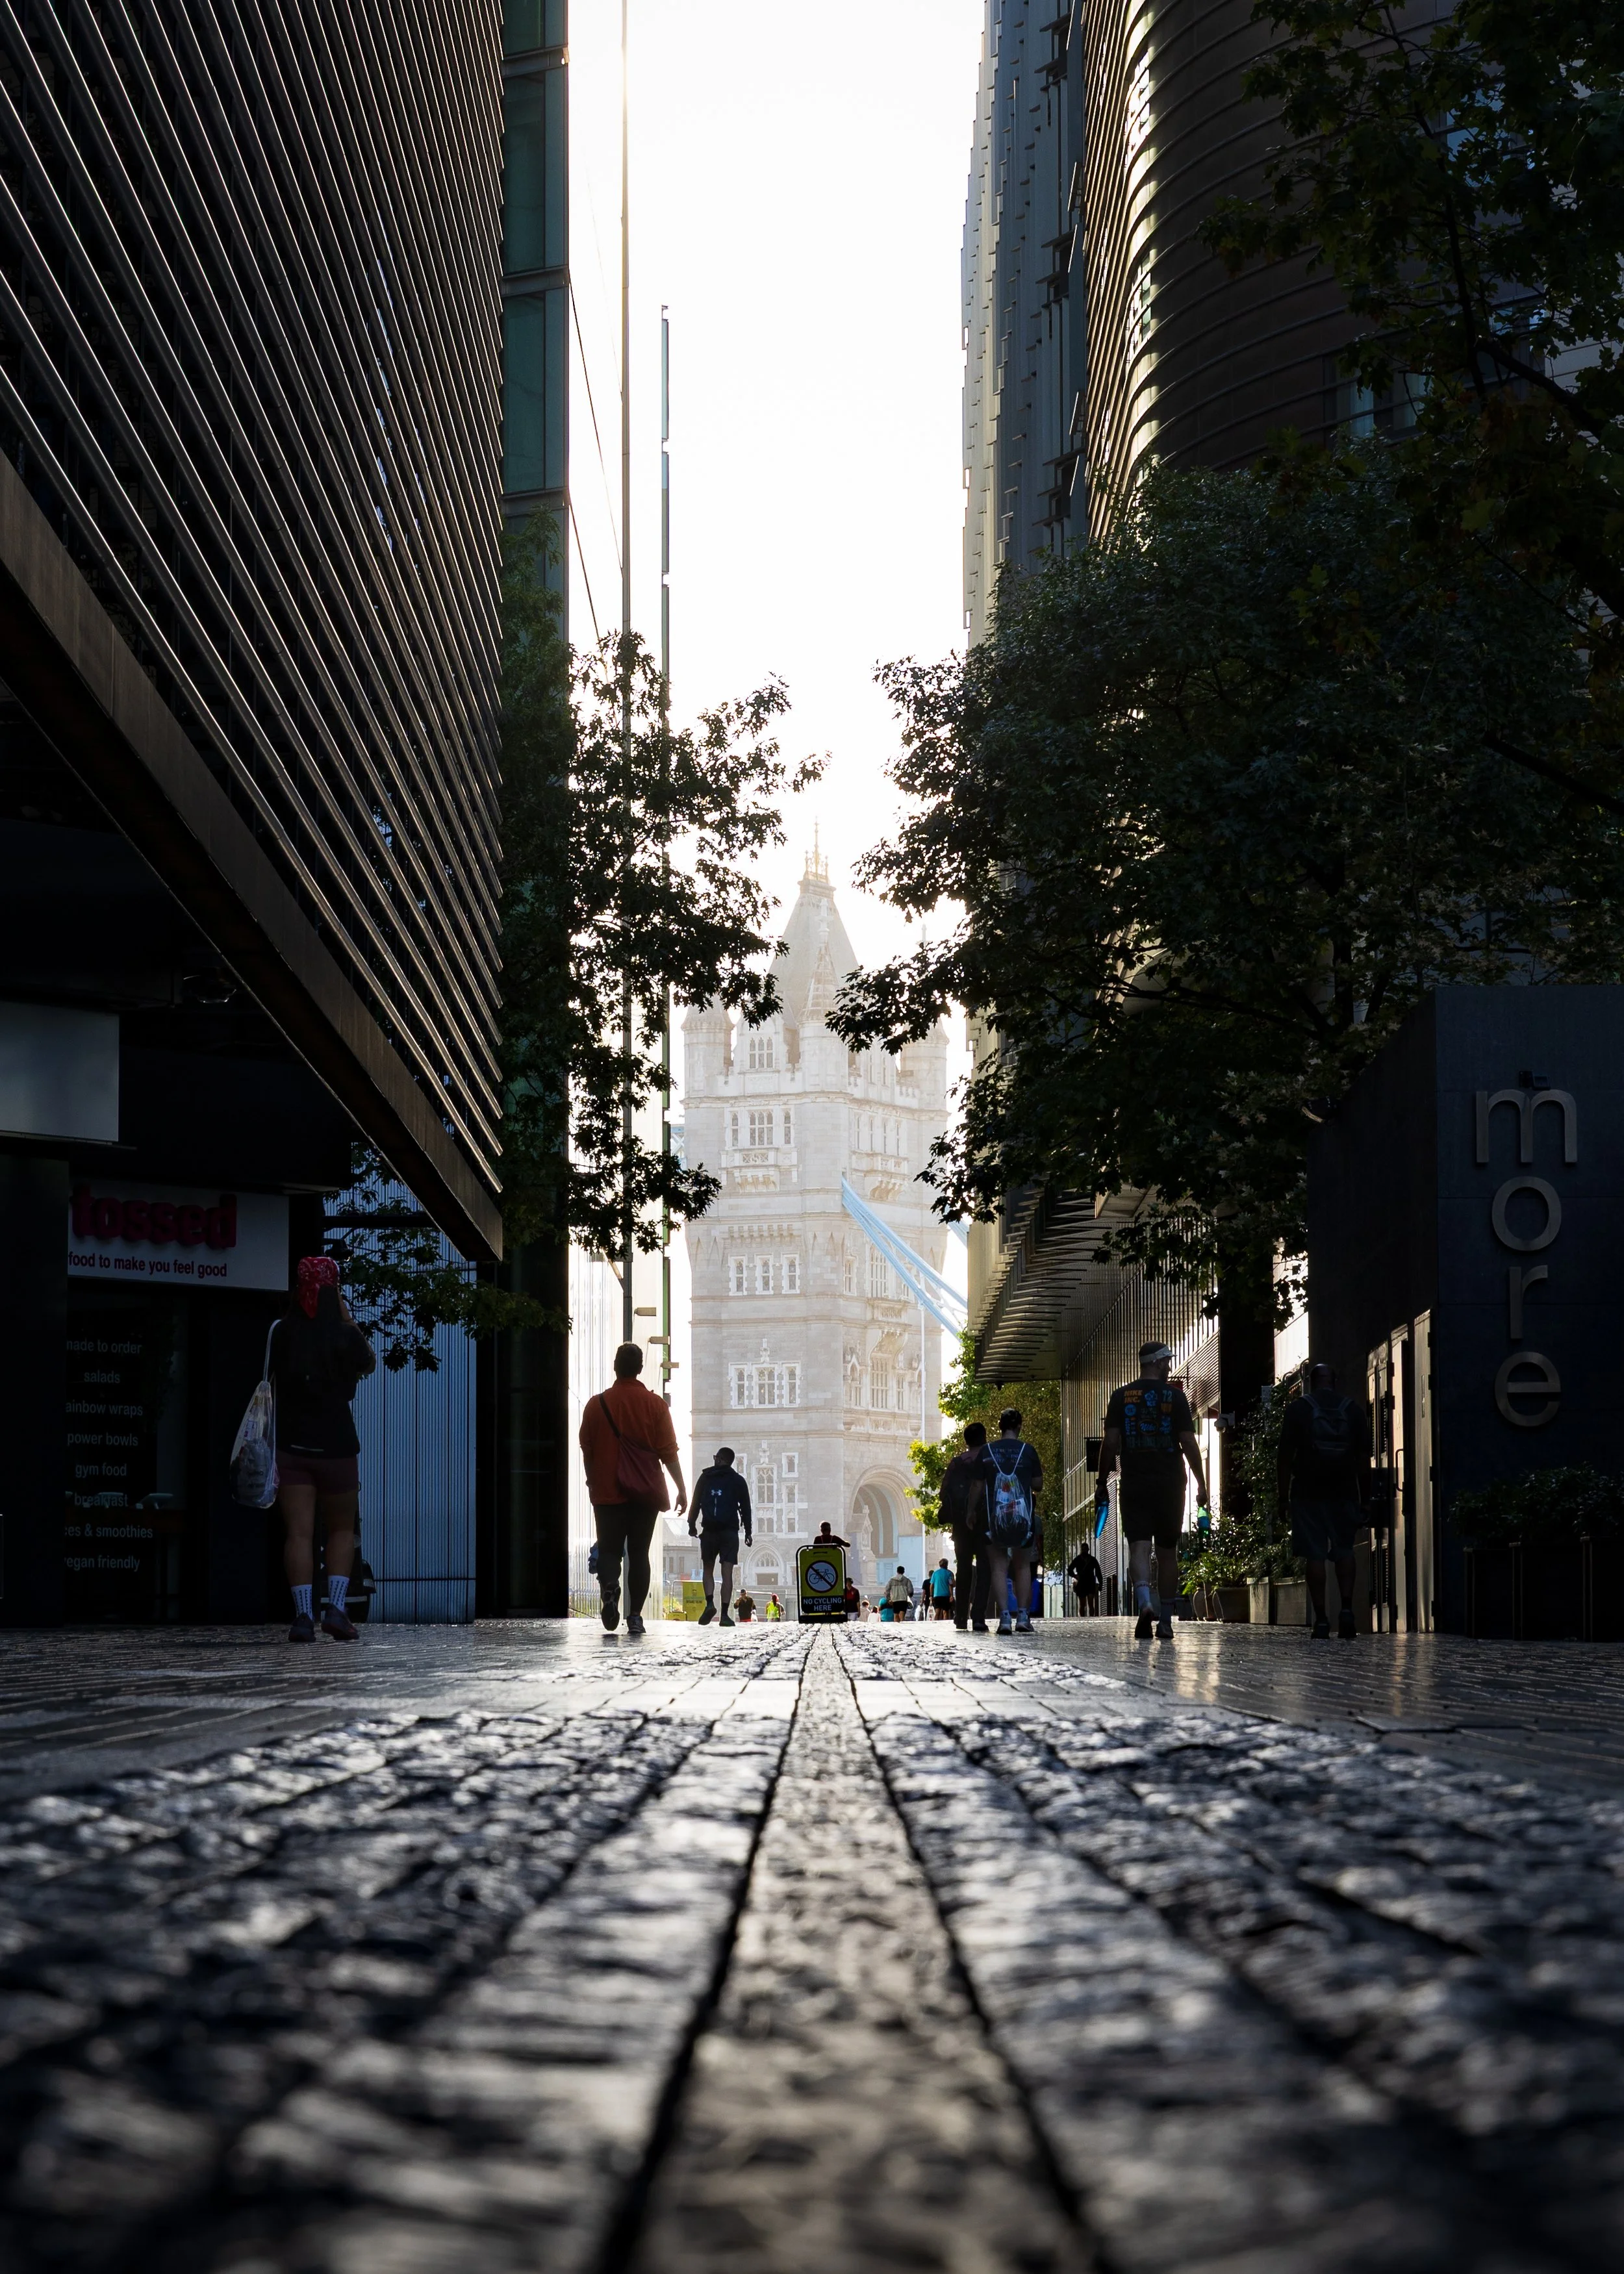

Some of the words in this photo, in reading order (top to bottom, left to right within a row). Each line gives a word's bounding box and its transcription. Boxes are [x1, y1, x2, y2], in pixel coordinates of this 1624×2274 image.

[70, 1183, 236, 1250] tossed
[68, 1252, 95, 1267] food
[99, 1254, 110, 1269] to
[114, 1257, 145, 1271] make
[149, 1263, 170, 1274] you
[173, 1259, 194, 1274] feel
[197, 1263, 227, 1278] good
[1475, 1089, 1578, 1428] more
[97, 1338, 108, 1352] to
[110, 1341, 142, 1354] order
[84, 1369, 121, 1383] salads
[1161, 1390, 1173, 1402] 72
[65, 1398, 107, 1415] ainbow
[108, 1404, 144, 1419] wraps
[66, 1433, 103, 1447] power
[105, 1431, 139, 1447] bowls
[75, 1463, 99, 1479] gym
[101, 1461, 128, 1477] food
[74, 1491, 129, 1508] breakfast
[84, 1523, 93, 1537] &
[95, 1524, 154, 1539] smoothies
[97, 1554, 141, 1573] friendly
